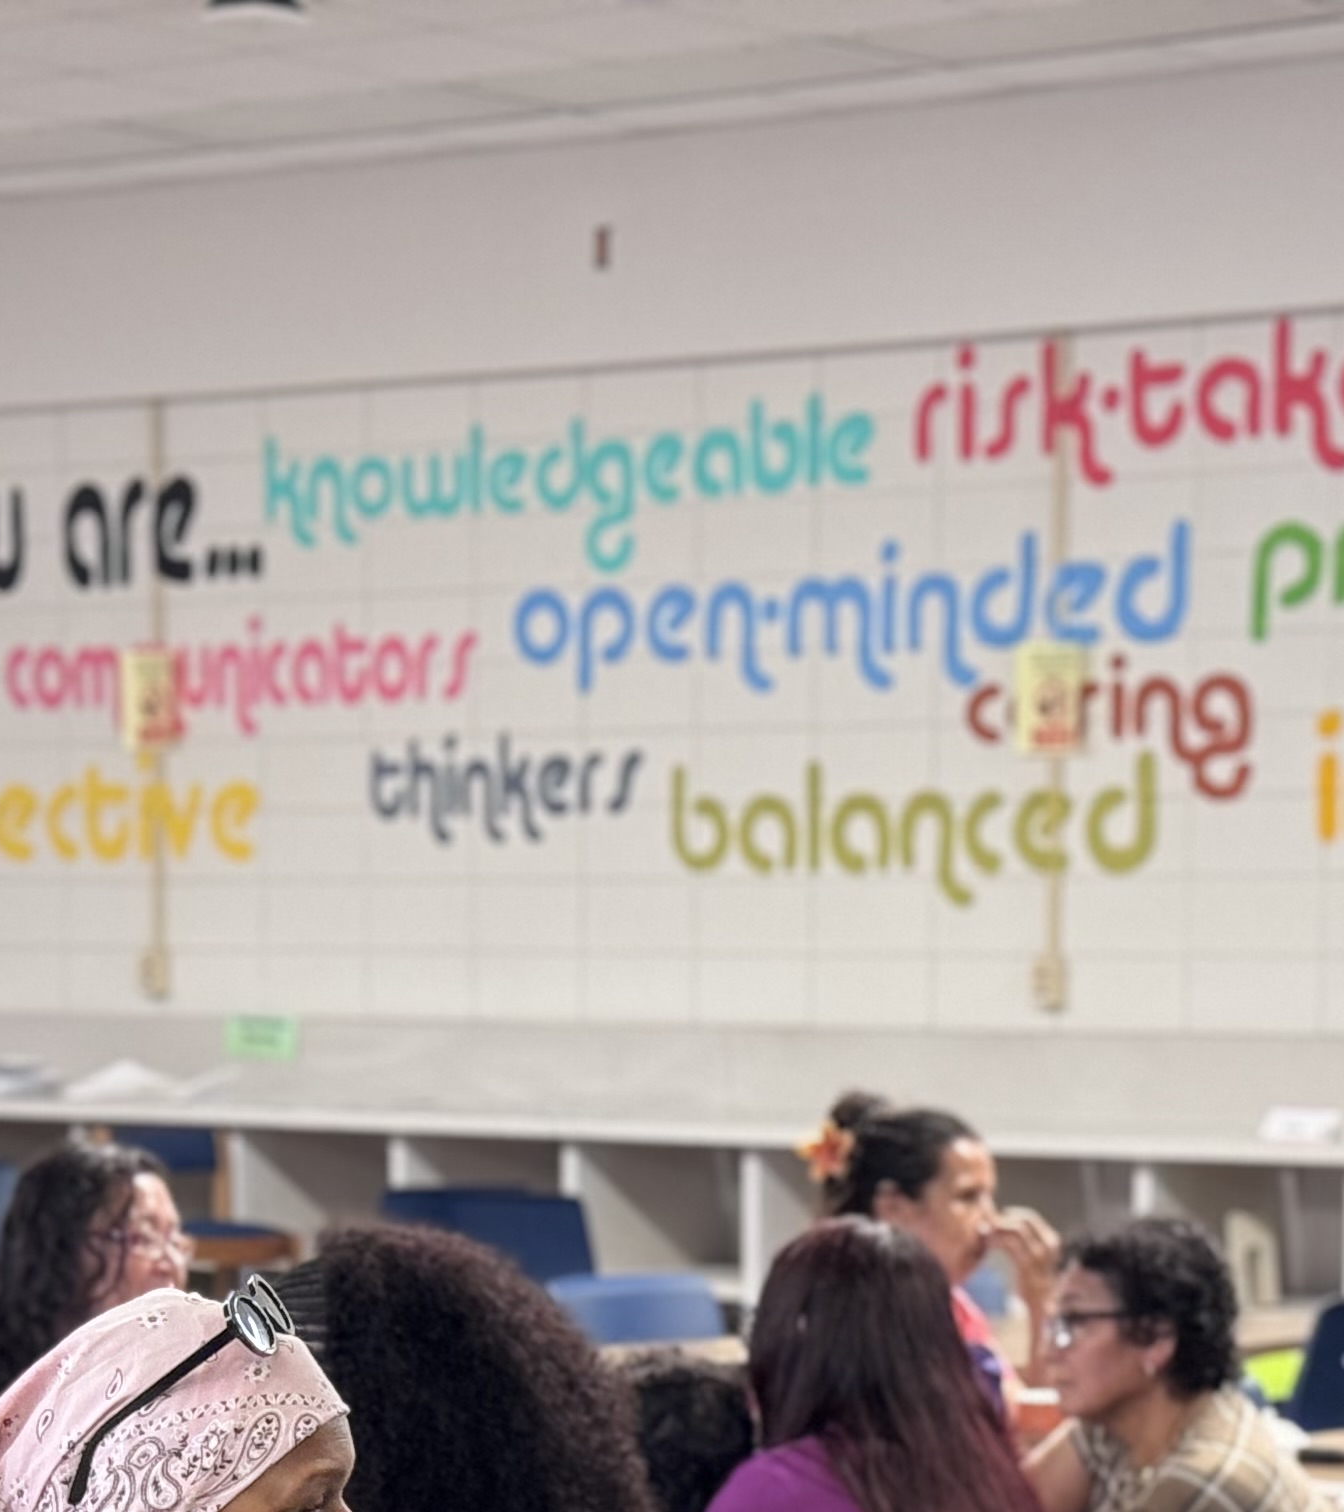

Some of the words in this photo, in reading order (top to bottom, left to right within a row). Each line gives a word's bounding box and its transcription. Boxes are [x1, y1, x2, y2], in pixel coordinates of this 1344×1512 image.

[61, 472, 264, 588] are...
[264, 396, 877, 574] knowledgeable
[4, 614, 479, 738] comunicators
[964, 652, 1253, 802] cring
[369, 733, 644, 846] thinkers
[670, 750, 1159, 908] balanced
